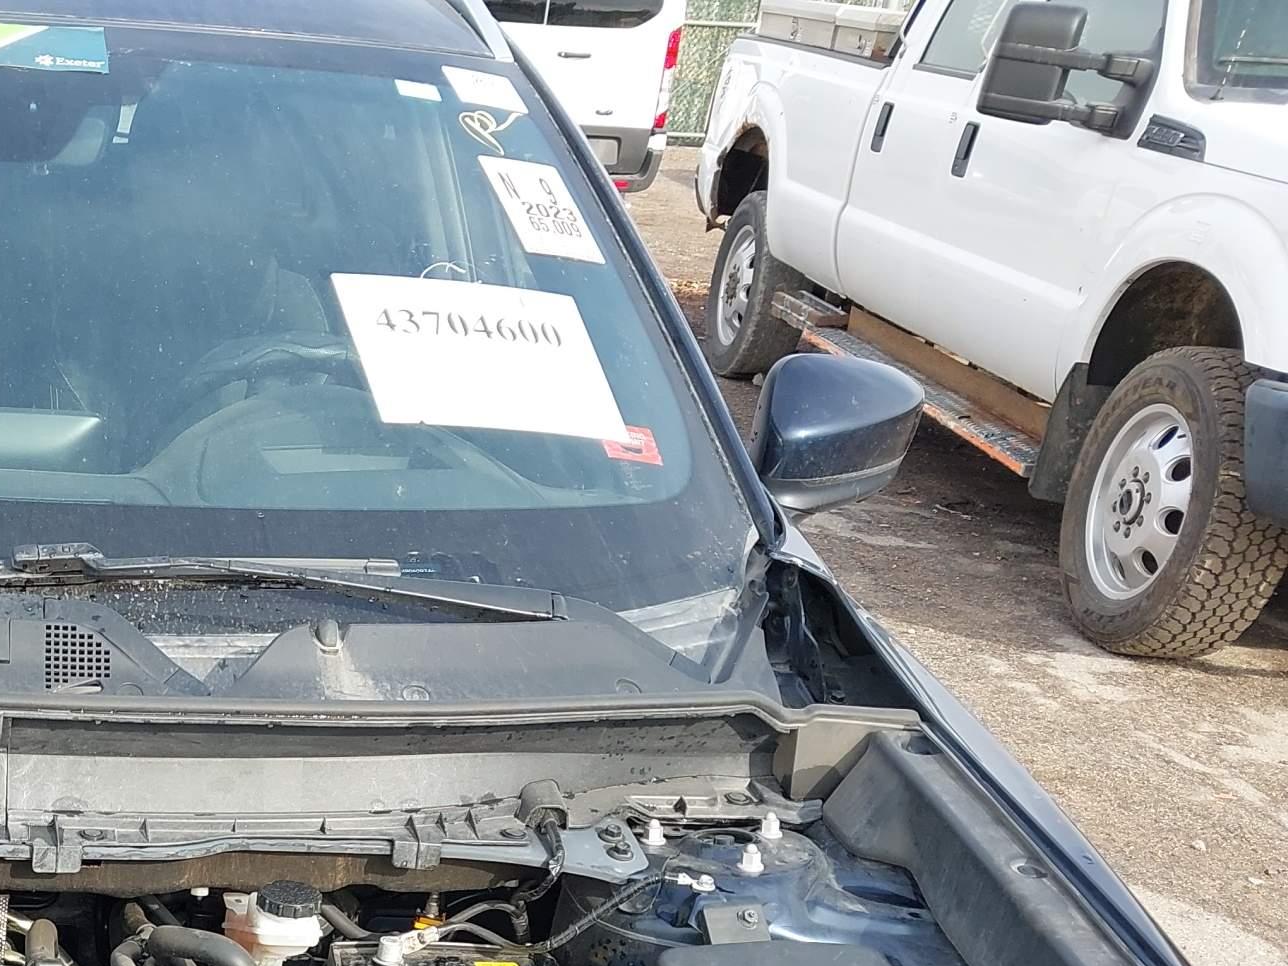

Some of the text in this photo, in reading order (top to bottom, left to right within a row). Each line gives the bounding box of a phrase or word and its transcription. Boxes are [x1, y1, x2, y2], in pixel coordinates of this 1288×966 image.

[55, 56, 105, 68] Exeter
[497, 171, 521, 200] N
[520, 201, 578, 223] 2023
[376, 307, 563, 347] 43704600
